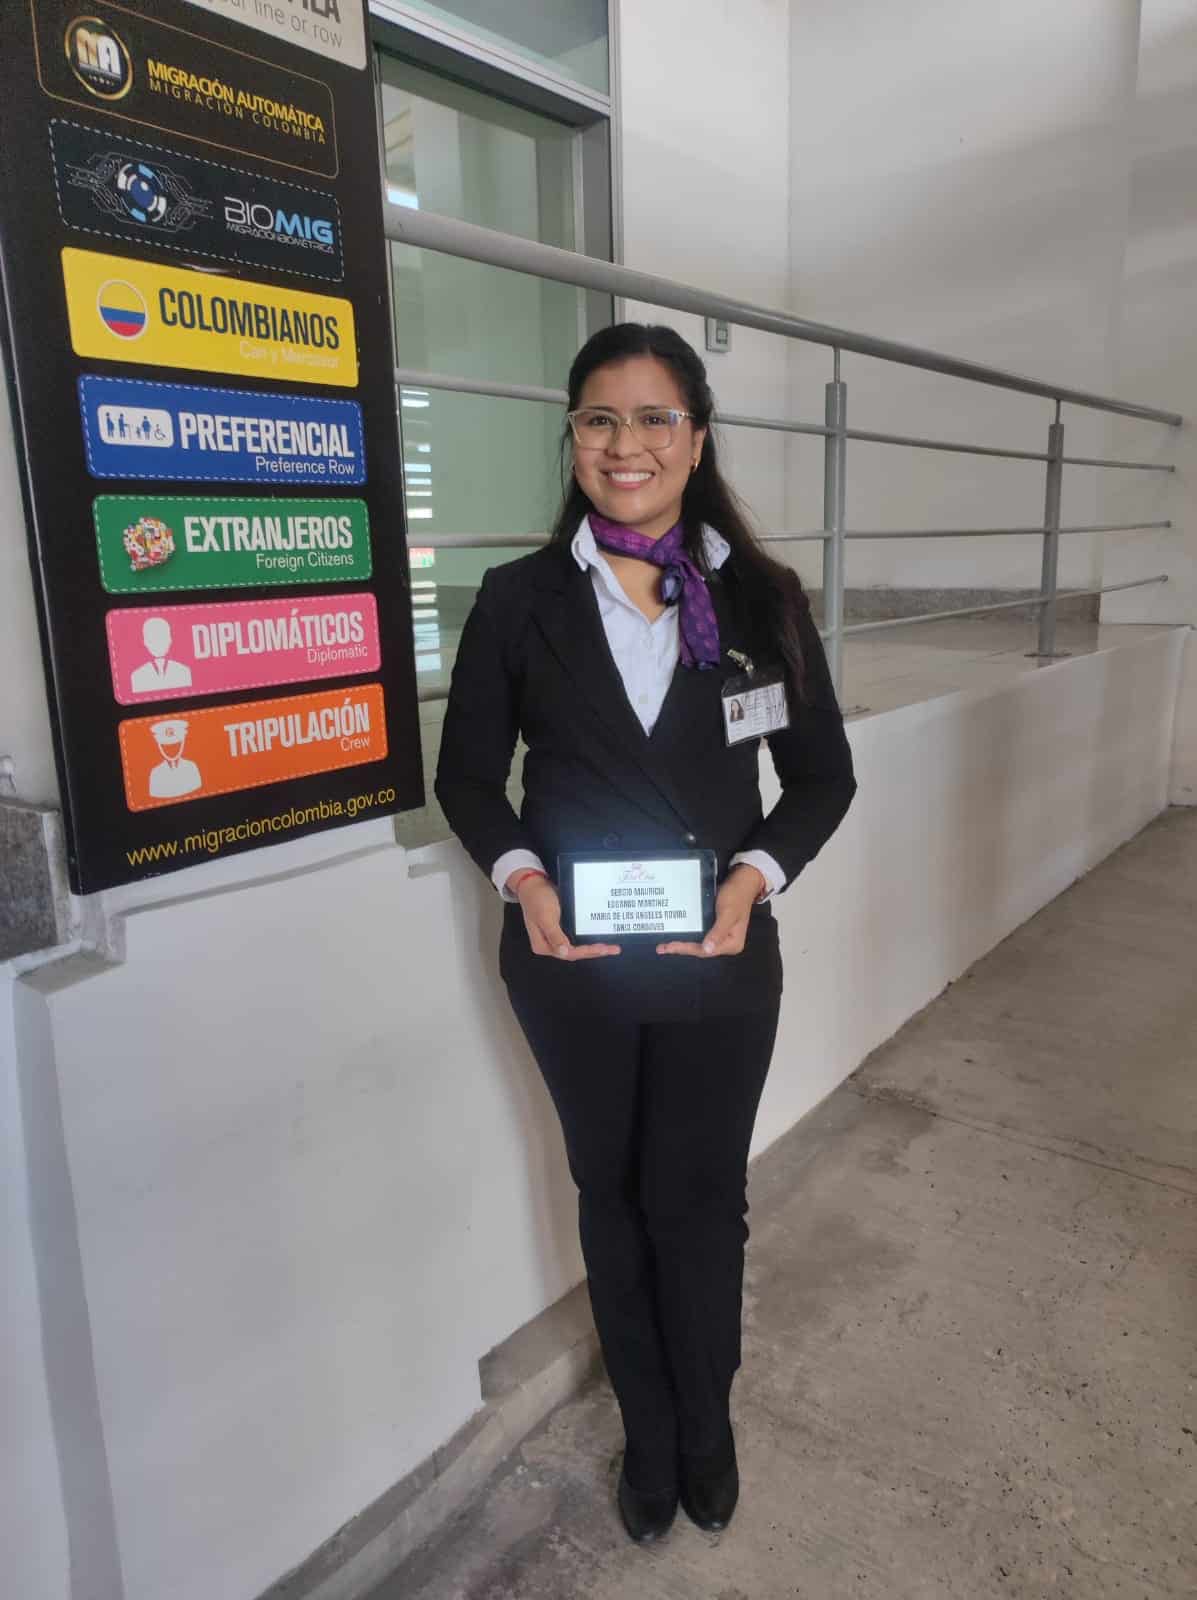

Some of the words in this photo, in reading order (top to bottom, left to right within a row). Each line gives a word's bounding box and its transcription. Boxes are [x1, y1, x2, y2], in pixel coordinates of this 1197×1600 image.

[290, 15, 308, 32] or
[311, 24, 343, 48] row
[147, 58, 234, 103] MIGRACIÓN
[236, 90, 325, 133] AUTOMÁTICA
[251, 111, 326, 145] COLOMBIA
[223, 195, 334, 245] BIOMIG
[158, 287, 341, 350] COLOMBIANOS
[178, 411, 355, 458] PREFERENCIAL
[255, 456, 325, 475] Preference
[328, 460, 355, 475] Row
[183, 515, 354, 553] EXTRANJEROS
[256, 554, 303, 573] Foreign
[308, 551, 354, 569] Citizens
[191, 608, 365, 659] DIPLOMÁTICOS
[307, 644, 368, 666] Diplomatic
[223, 698, 370, 758] TRIPULACIÓN
[340, 736, 371, 752] Crew
[126, 788, 396, 866] www.migracioncolombia.gov.co
